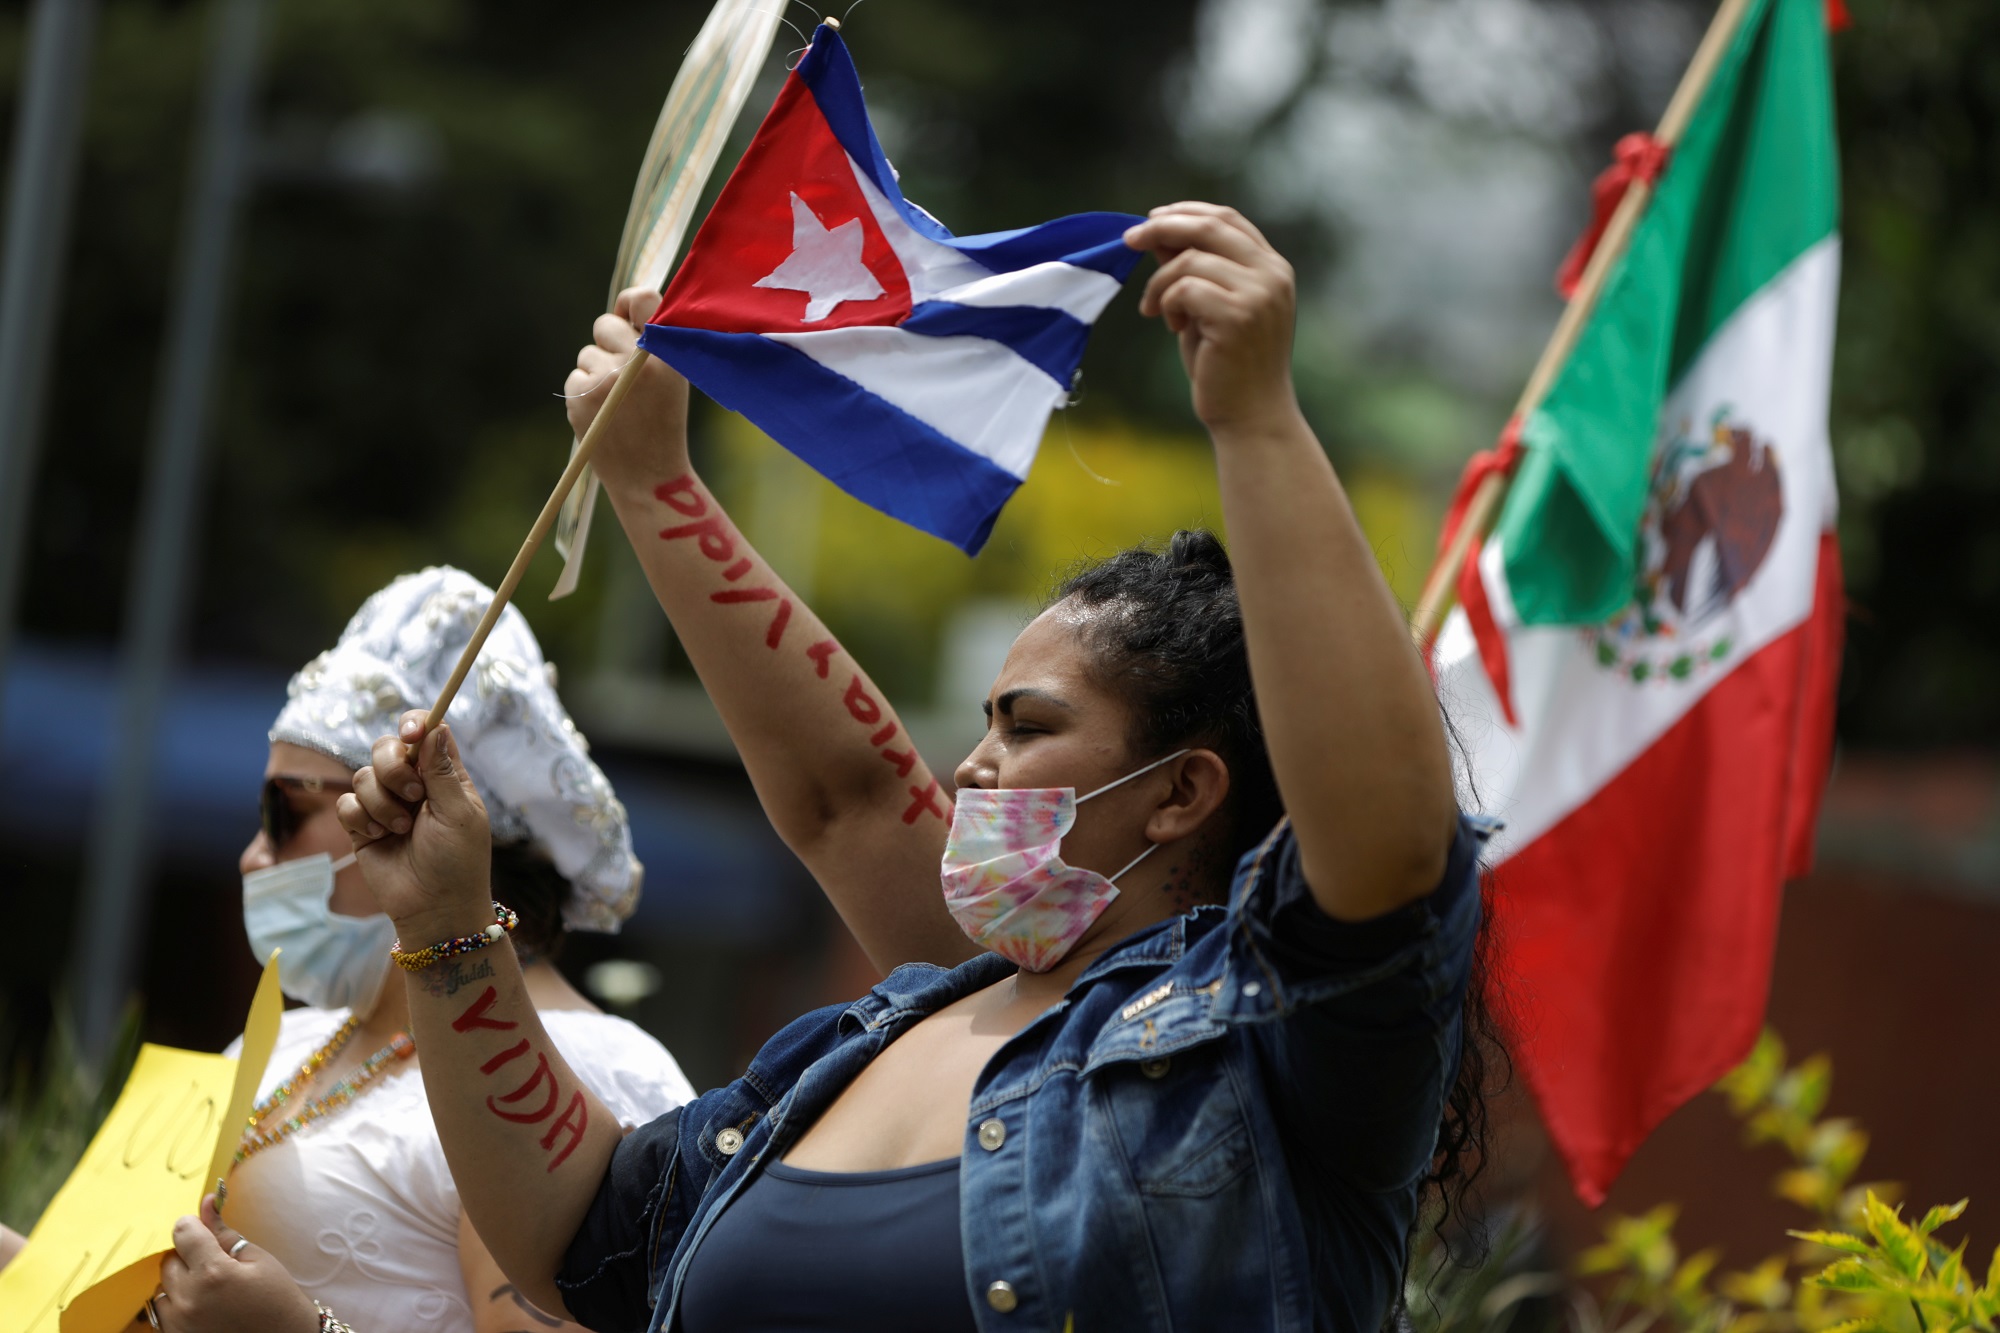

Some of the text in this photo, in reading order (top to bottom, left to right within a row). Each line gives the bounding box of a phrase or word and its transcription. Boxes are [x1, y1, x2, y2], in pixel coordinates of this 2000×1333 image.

[653, 473, 792, 650] Vida
[843, 674, 957, 828] tria
[451, 985, 589, 1174] VIDA
